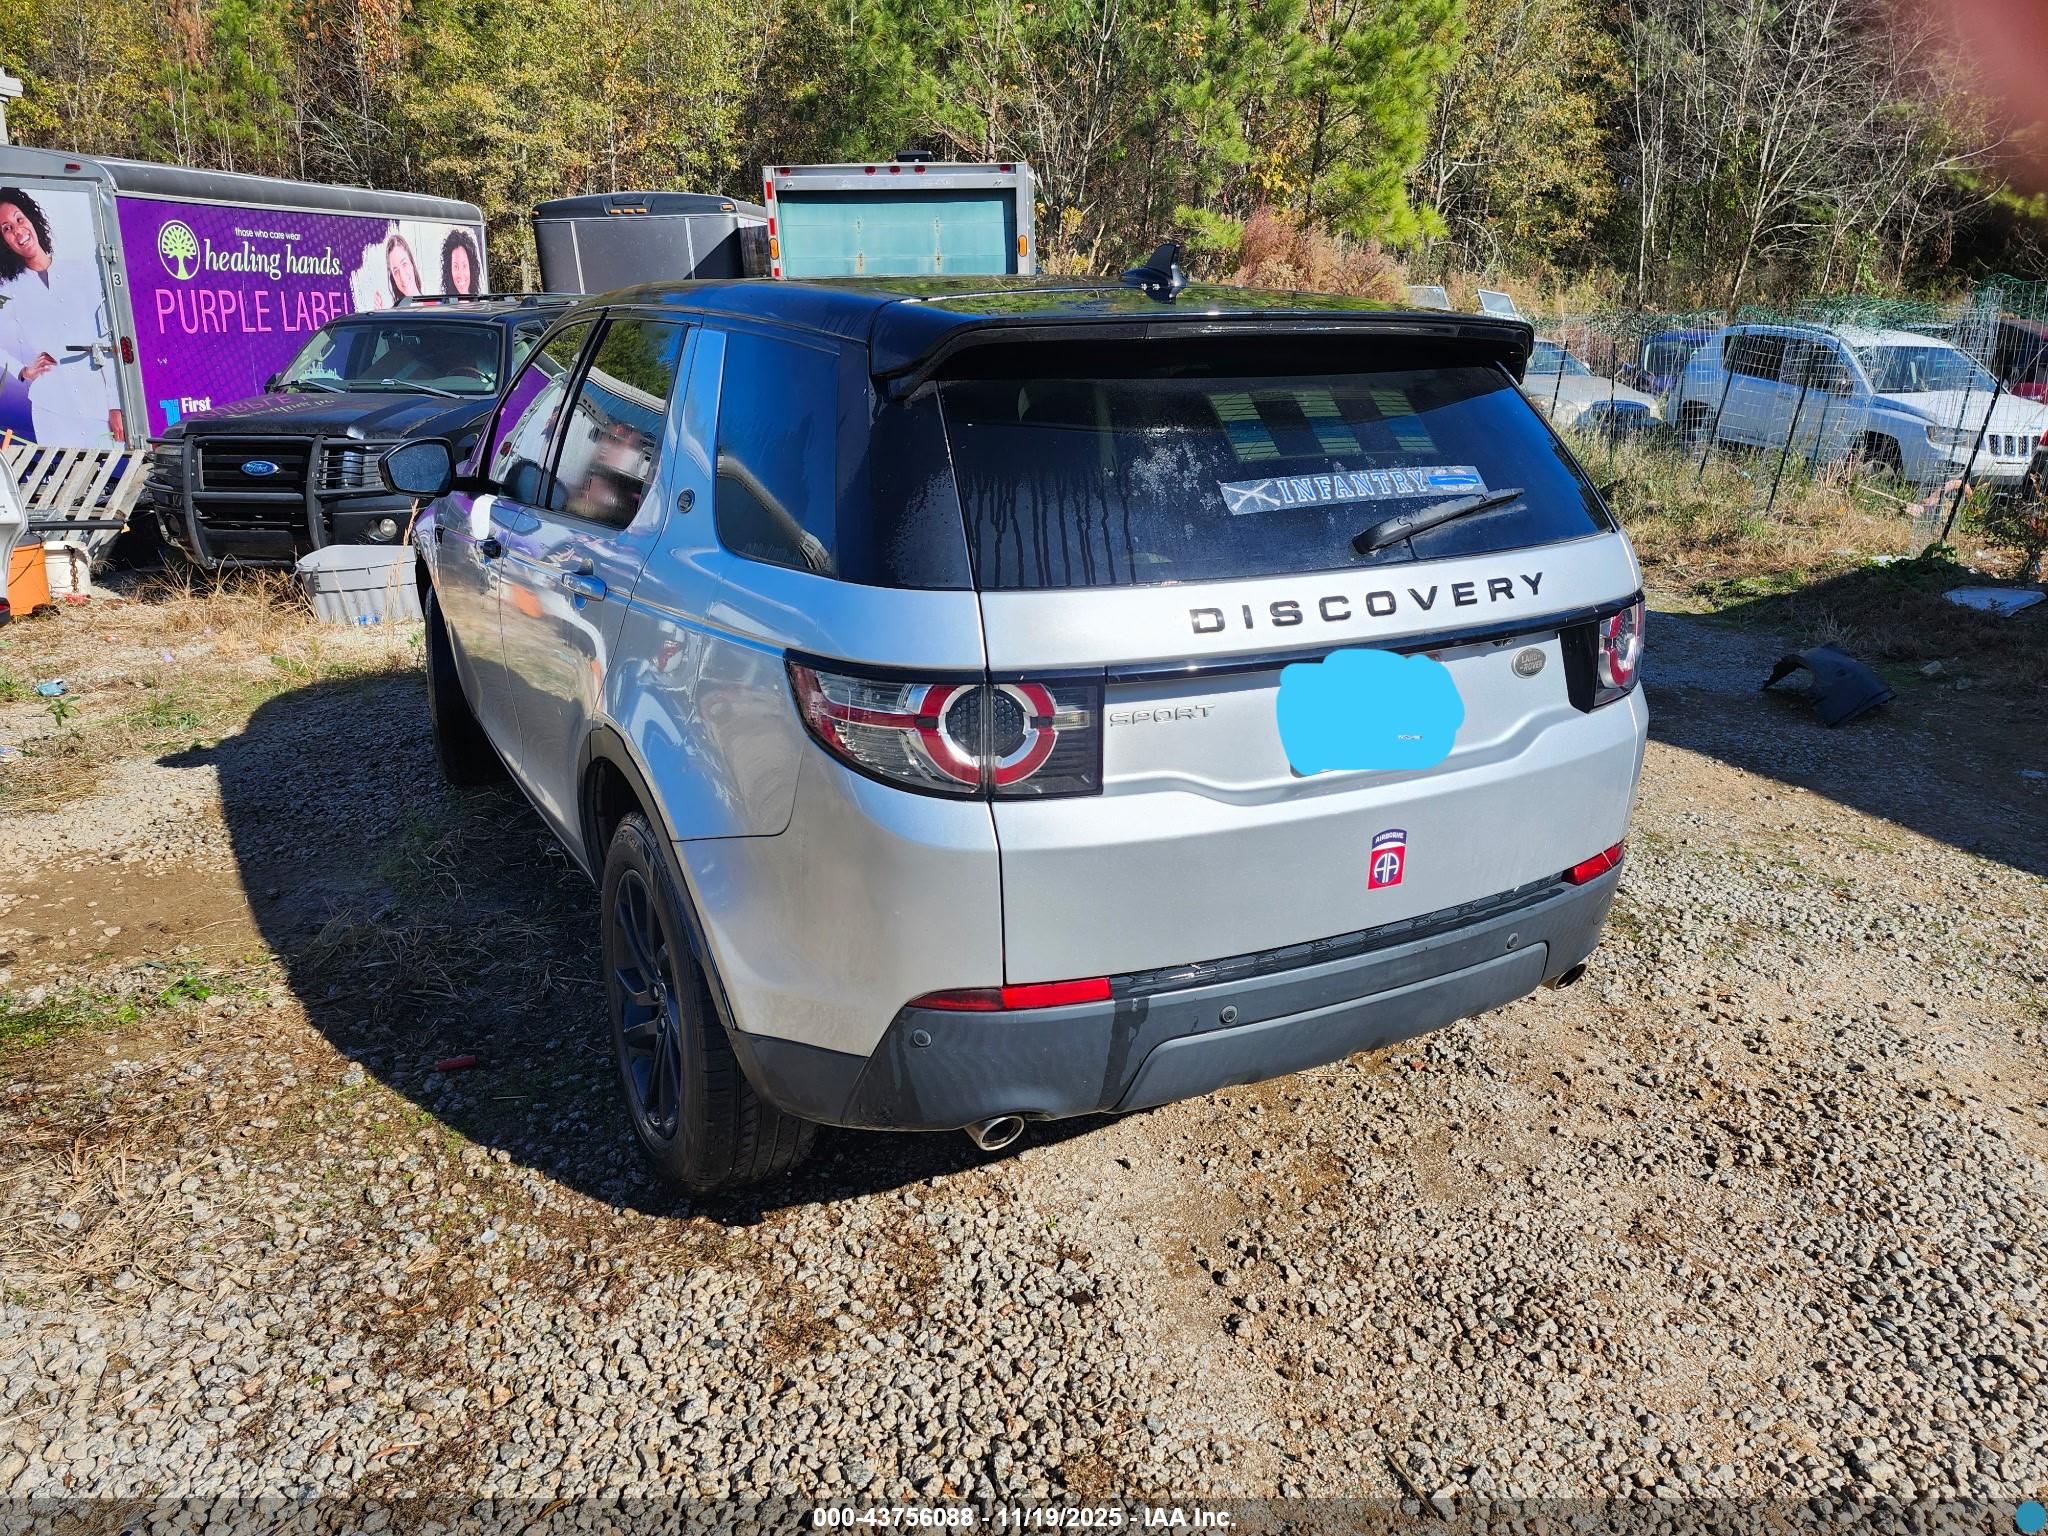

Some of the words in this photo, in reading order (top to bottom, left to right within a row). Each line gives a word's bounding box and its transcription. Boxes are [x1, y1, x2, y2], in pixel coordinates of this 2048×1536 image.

[235, 227, 254, 237] those
[254, 229, 269, 239] who
[269, 231, 285, 240] care
[285, 232, 302, 241] wear
[204, 239, 282, 280] healing
[114, 273, 121, 286] 3
[155, 289, 272, 334] PURPLE
[181, 396, 212, 414] First
[246, 462, 270, 473] Ford
[1277, 470, 1428, 503] INFANTRY
[1190, 572, 1543, 634] DISCOVERY
[1109, 703, 1217, 727] SPORT
[1375, 831, 1404, 843] AIRBORNE
